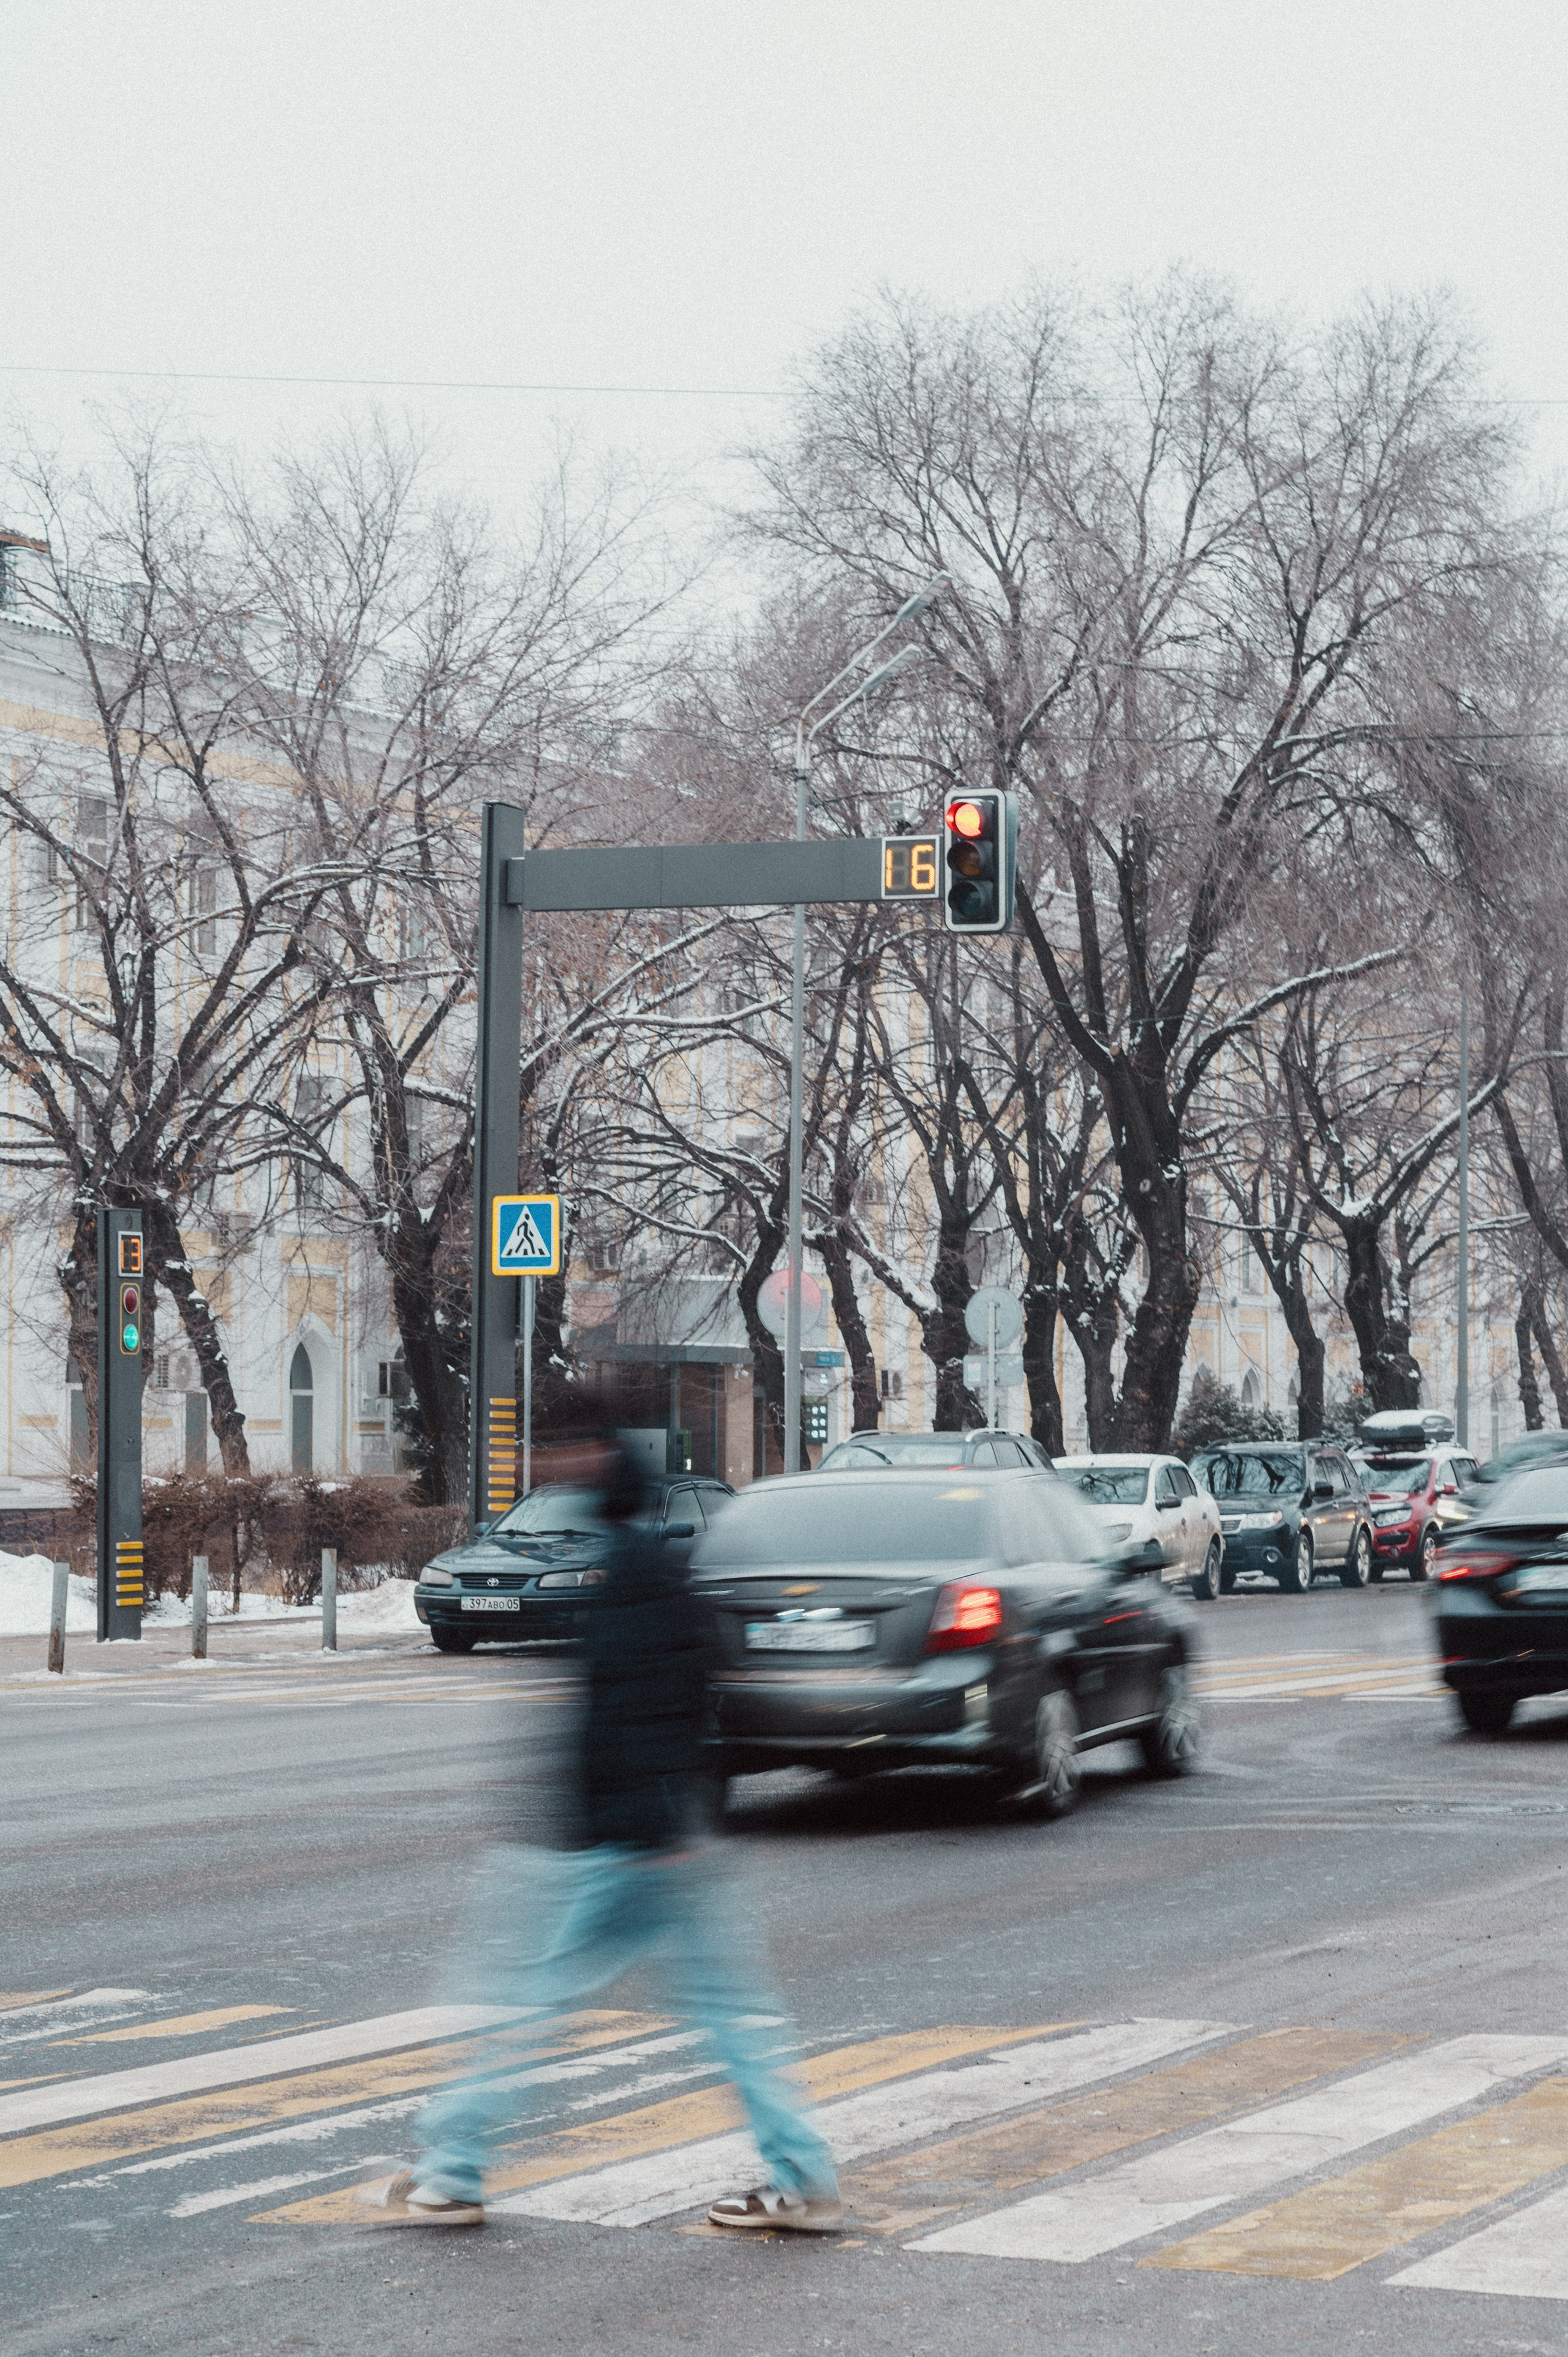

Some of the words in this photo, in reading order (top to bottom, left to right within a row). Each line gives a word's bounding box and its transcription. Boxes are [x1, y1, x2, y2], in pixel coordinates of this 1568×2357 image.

[885, 844, 935, 890] 16
[121, 1238, 141, 1272] 13
[507, 1599, 519, 1609] 05
